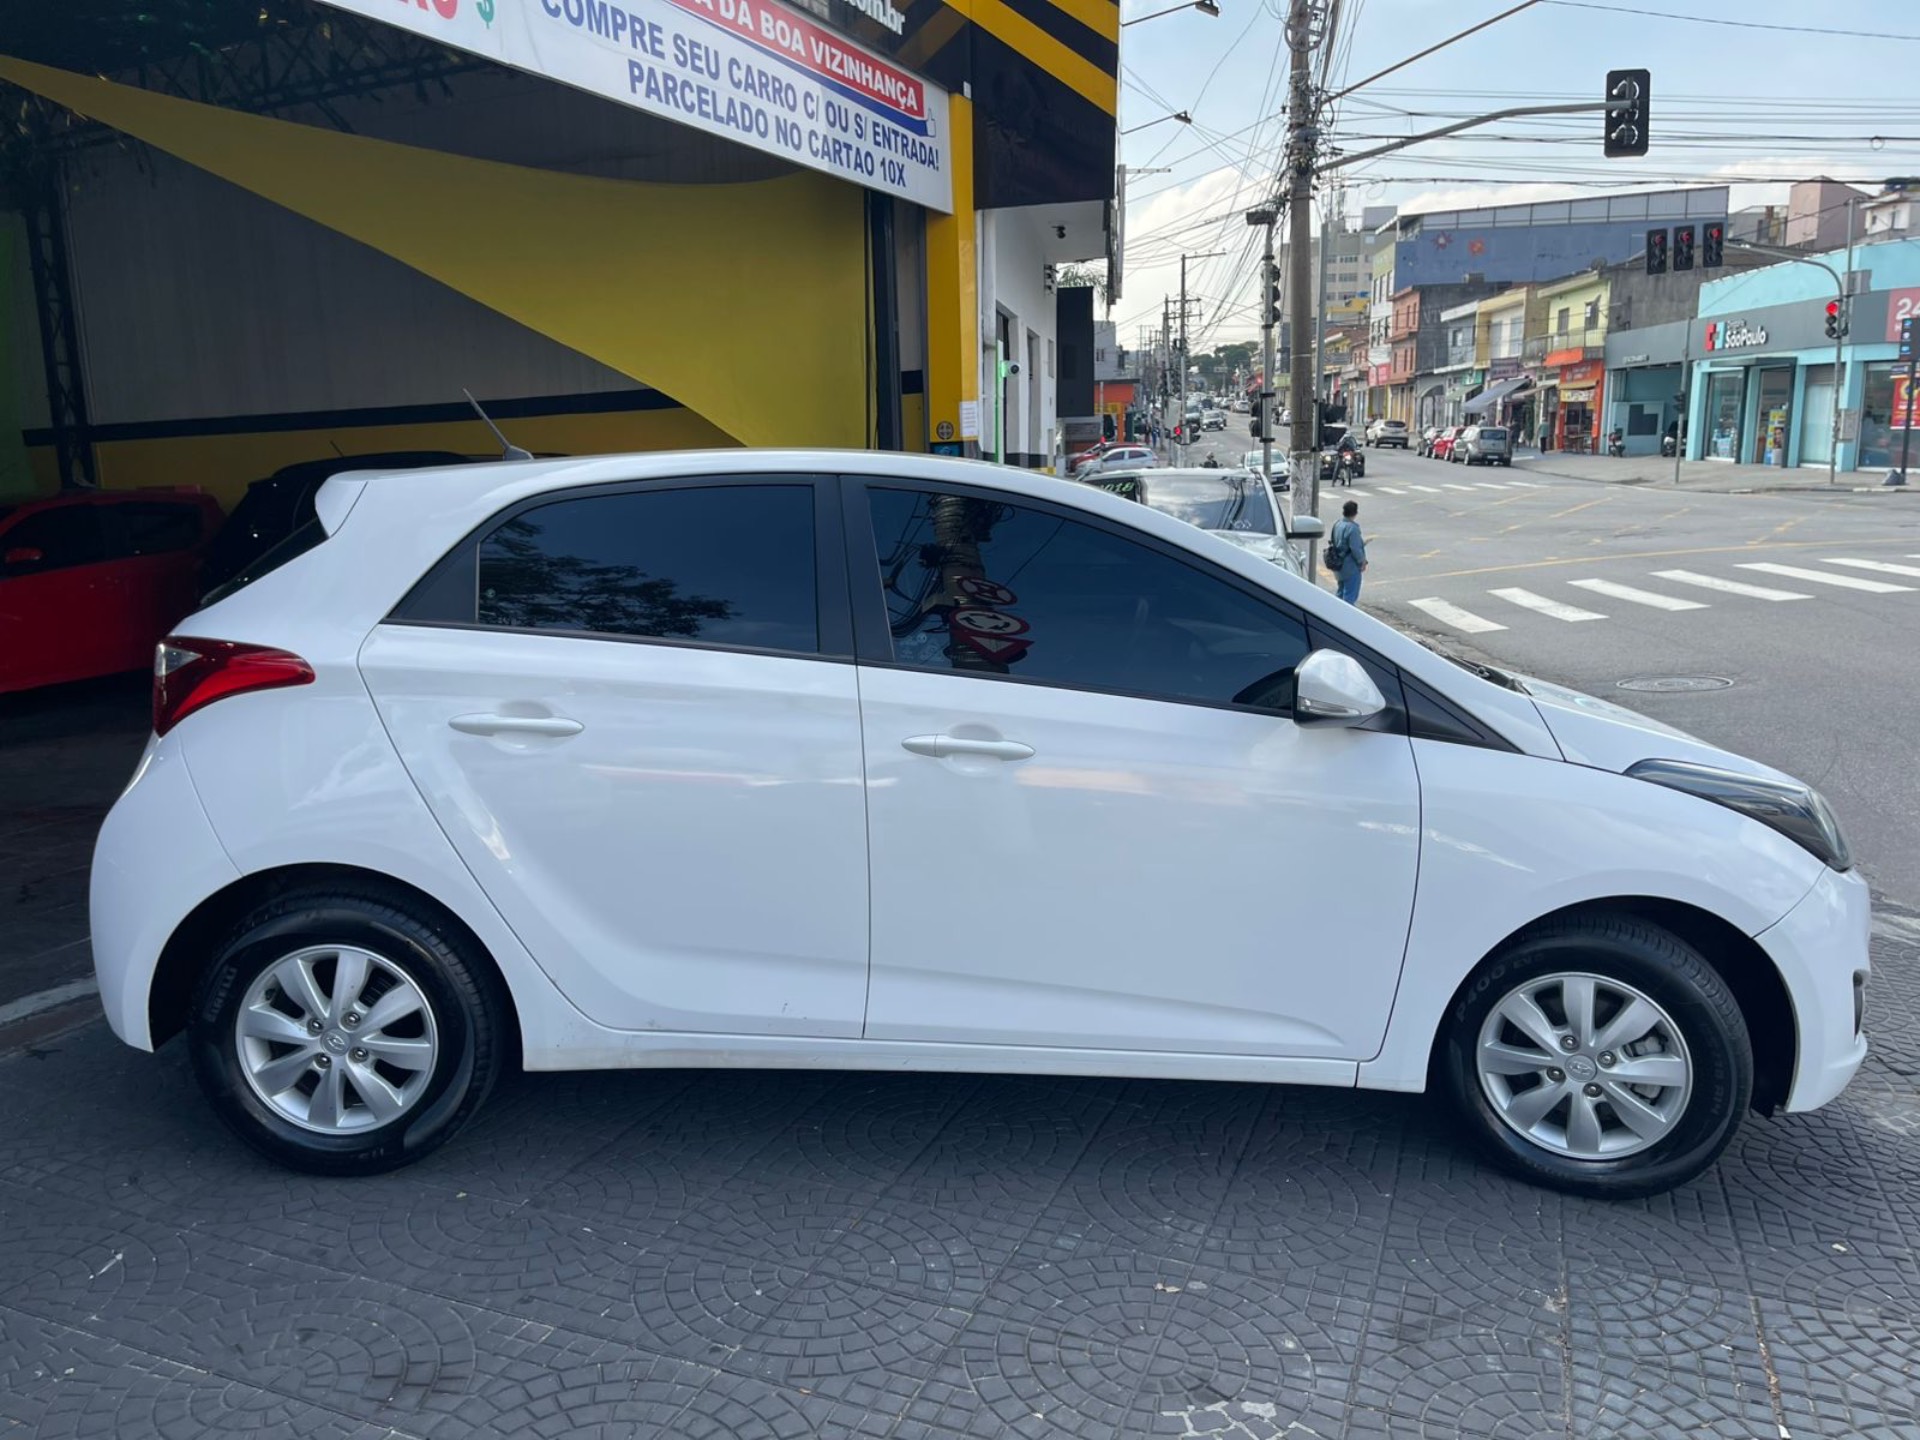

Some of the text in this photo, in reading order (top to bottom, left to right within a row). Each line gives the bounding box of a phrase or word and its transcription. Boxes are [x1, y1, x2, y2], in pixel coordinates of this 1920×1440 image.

[540, 0, 665, 60] COMPRE
[672, 33, 720, 81] SEU
[728, 57, 798, 112] CARRO
[803, 90, 819, 122] C/
[825, 100, 849, 133] OU
[854, 112, 868, 142] S/
[872, 120, 939, 171] ENTRADA!
[719, 0, 919, 111] DA BOA VIZINHANÇA
[627, 58, 769, 139] PARCELADO
[774, 115, 803, 151] NO
[880, 156, 907, 188] 10X
